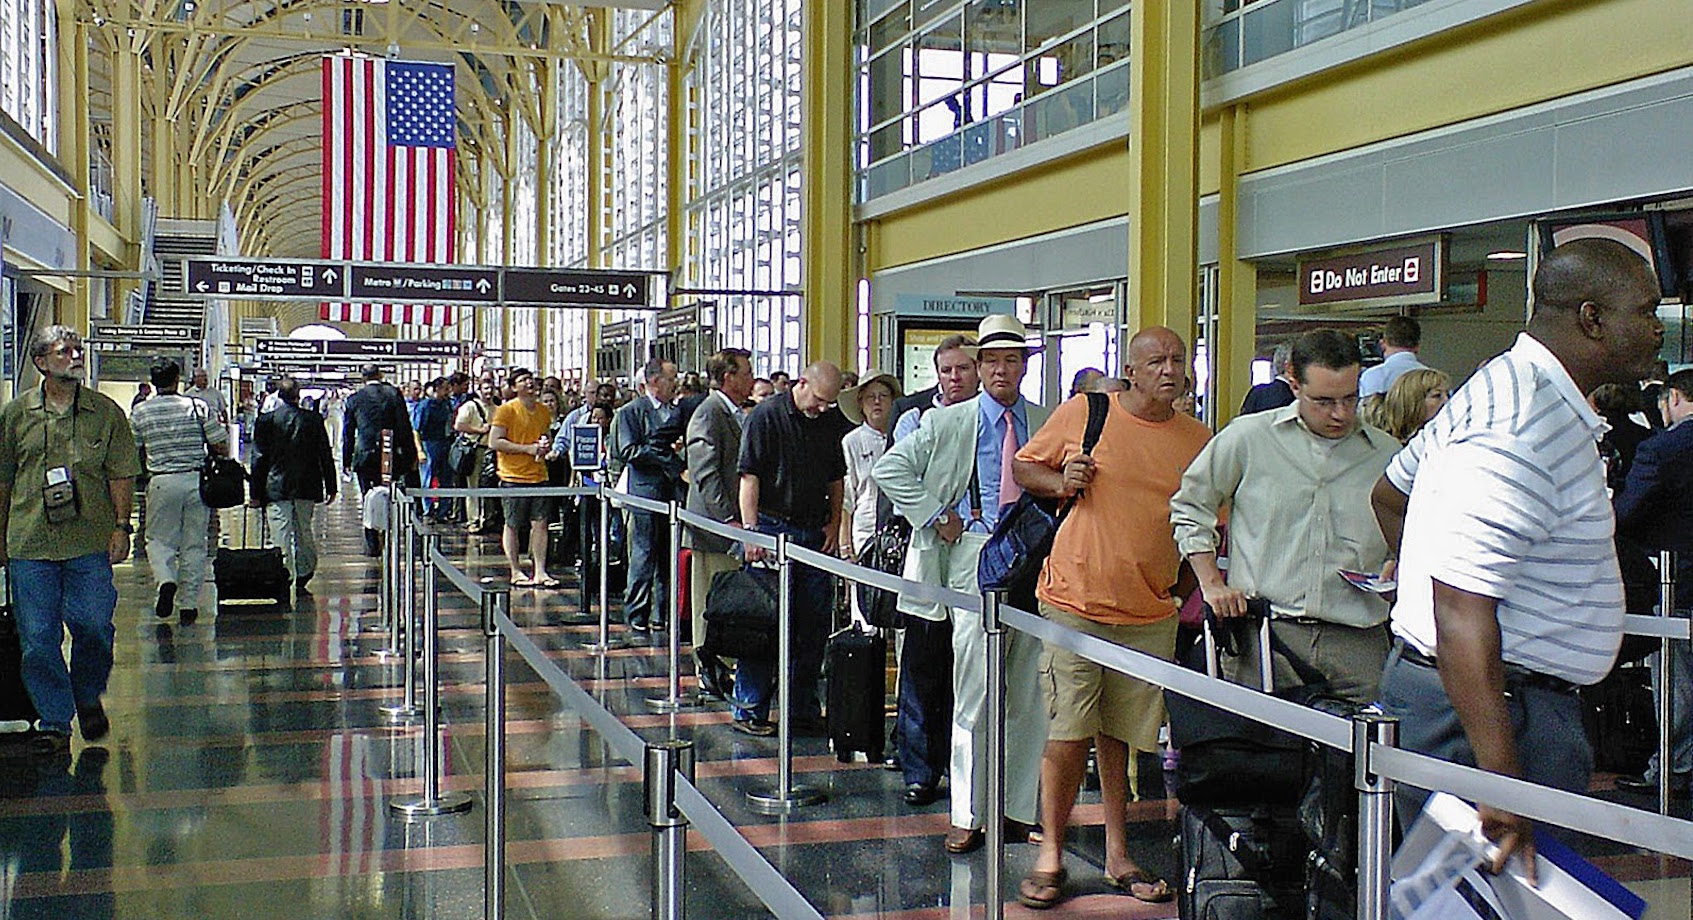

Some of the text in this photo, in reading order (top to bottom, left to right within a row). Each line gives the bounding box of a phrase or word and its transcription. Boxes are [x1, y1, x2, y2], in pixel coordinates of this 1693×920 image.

[211, 263, 296, 275] Ticketing/Check In
[252, 275, 296, 284] Restroom
[364, 278, 391, 287] Metro
[1325, 265, 1401, 290] Do Not Enter
[236, 283, 283, 293] Mail Drop
[550, 284, 576, 293] Gates
[923, 300, 991, 312] DIRECTORY
